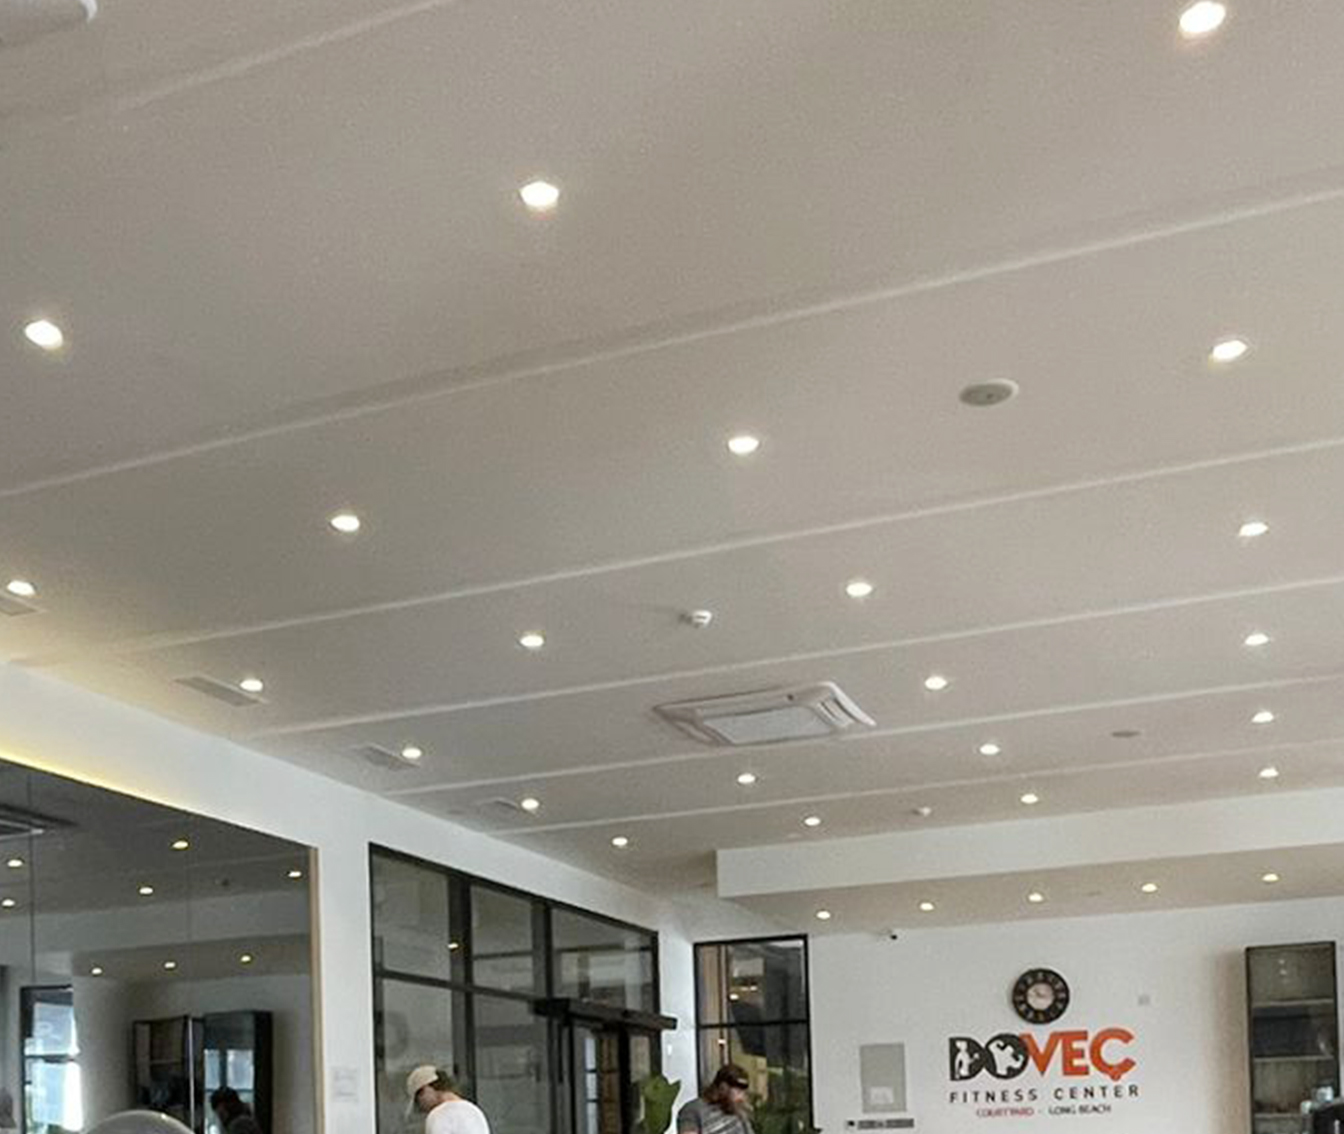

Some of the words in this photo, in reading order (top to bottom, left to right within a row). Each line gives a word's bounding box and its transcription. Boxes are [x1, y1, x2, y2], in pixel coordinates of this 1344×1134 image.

[949, 1087, 1039, 1103] FITNESS
[1054, 1084, 1140, 1101] CENTER
[1048, 1105, 1077, 1116] LONG
